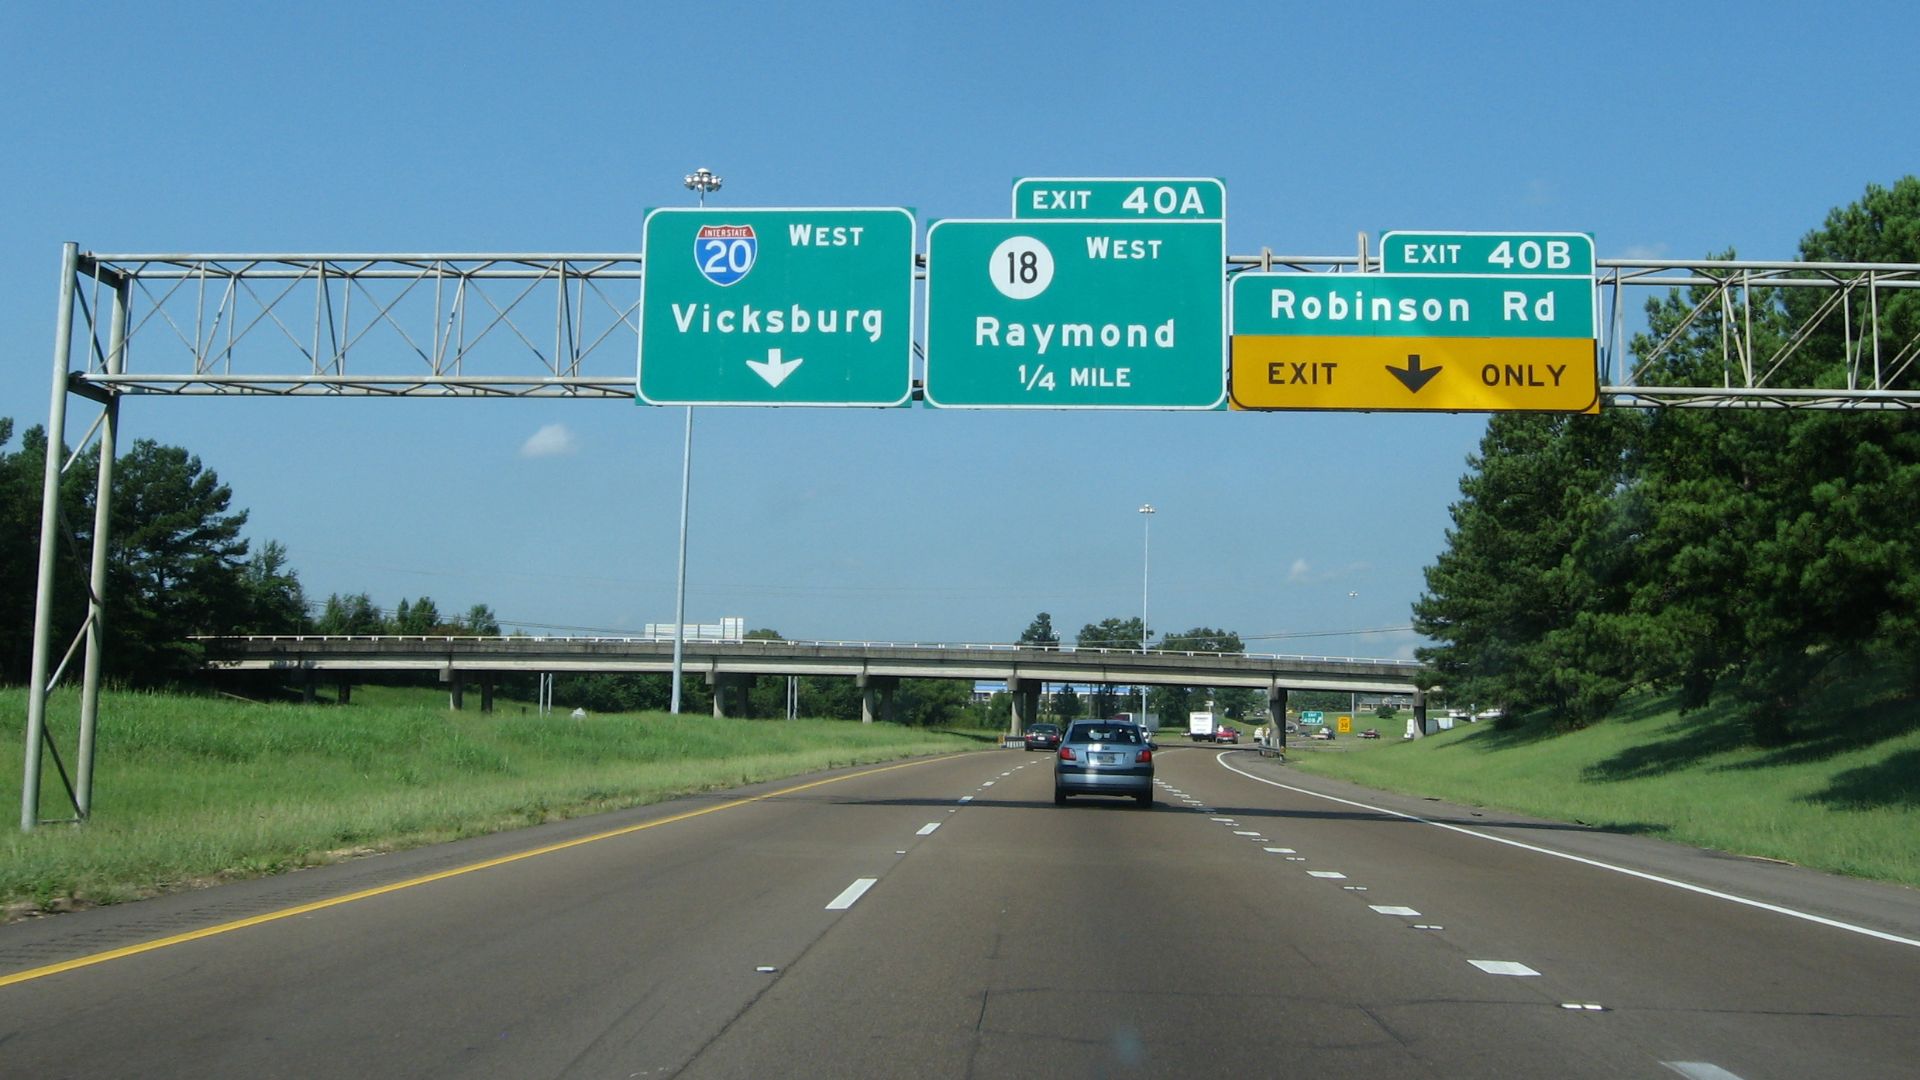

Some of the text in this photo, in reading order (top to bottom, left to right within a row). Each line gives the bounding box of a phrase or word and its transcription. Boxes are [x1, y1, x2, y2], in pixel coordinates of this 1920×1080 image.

[1032, 186, 1206, 214] EXIT 40A
[704, 229, 747, 237] INTERSTATE
[789, 223, 864, 247] WEST
[704, 240, 752, 273] 20
[1086, 236, 1163, 260] WEST
[1404, 240, 1571, 269] EXIT 40B
[1007, 250, 1038, 284] 18
[1271, 288, 1555, 322] Robinson Rd
[671, 303, 882, 343] Vicksburg
[975, 316, 1175, 355] Raymond
[1018, 364, 1131, 391] 1/4 MILE
[1268, 362, 1567, 387] EXIT ONLY
